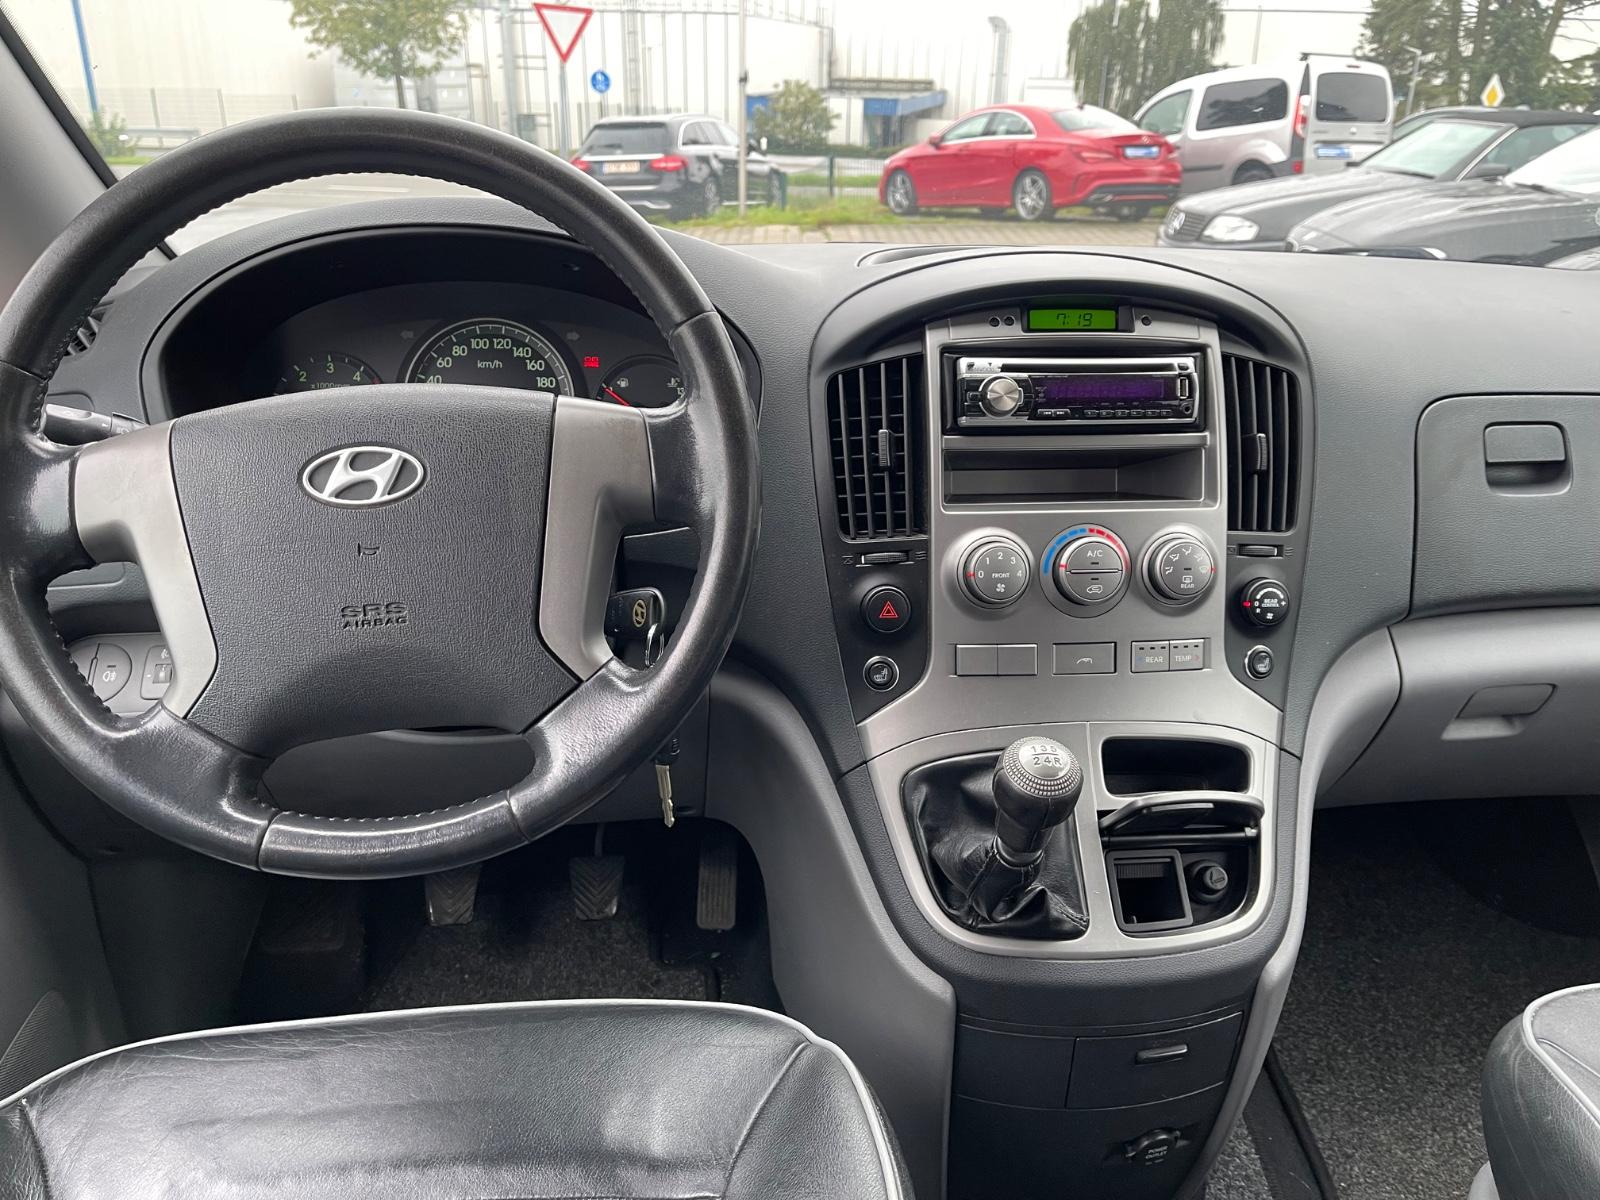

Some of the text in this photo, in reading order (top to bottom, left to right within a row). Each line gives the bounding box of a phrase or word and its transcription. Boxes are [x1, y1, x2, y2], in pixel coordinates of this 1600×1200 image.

[470, 338, 489, 350] 100
[493, 338, 512, 350] 120
[451, 345, 468, 357] 80
[513, 347, 532, 358] 140
[436, 356, 453, 368] 60
[477, 359, 503, 369] km/h
[525, 359, 545, 371] 160
[326, 362, 335, 374] 3
[299, 370, 308, 382] 2
[352, 371, 361, 382] 4
[426, 374, 443, 384] 40
[536, 376, 556, 388] 180
[997, 551, 1004, 560] 2
[1087, 549, 1103, 558] A/C
[985, 557, 990, 565] 1
[1010, 556, 1016, 565] 3
[978, 570, 985, 579] 0
[1016, 570, 1022, 578] 4
[343, 616, 407, 629] AIRBAG
[1032, 756, 1062, 766] 2 4 R
